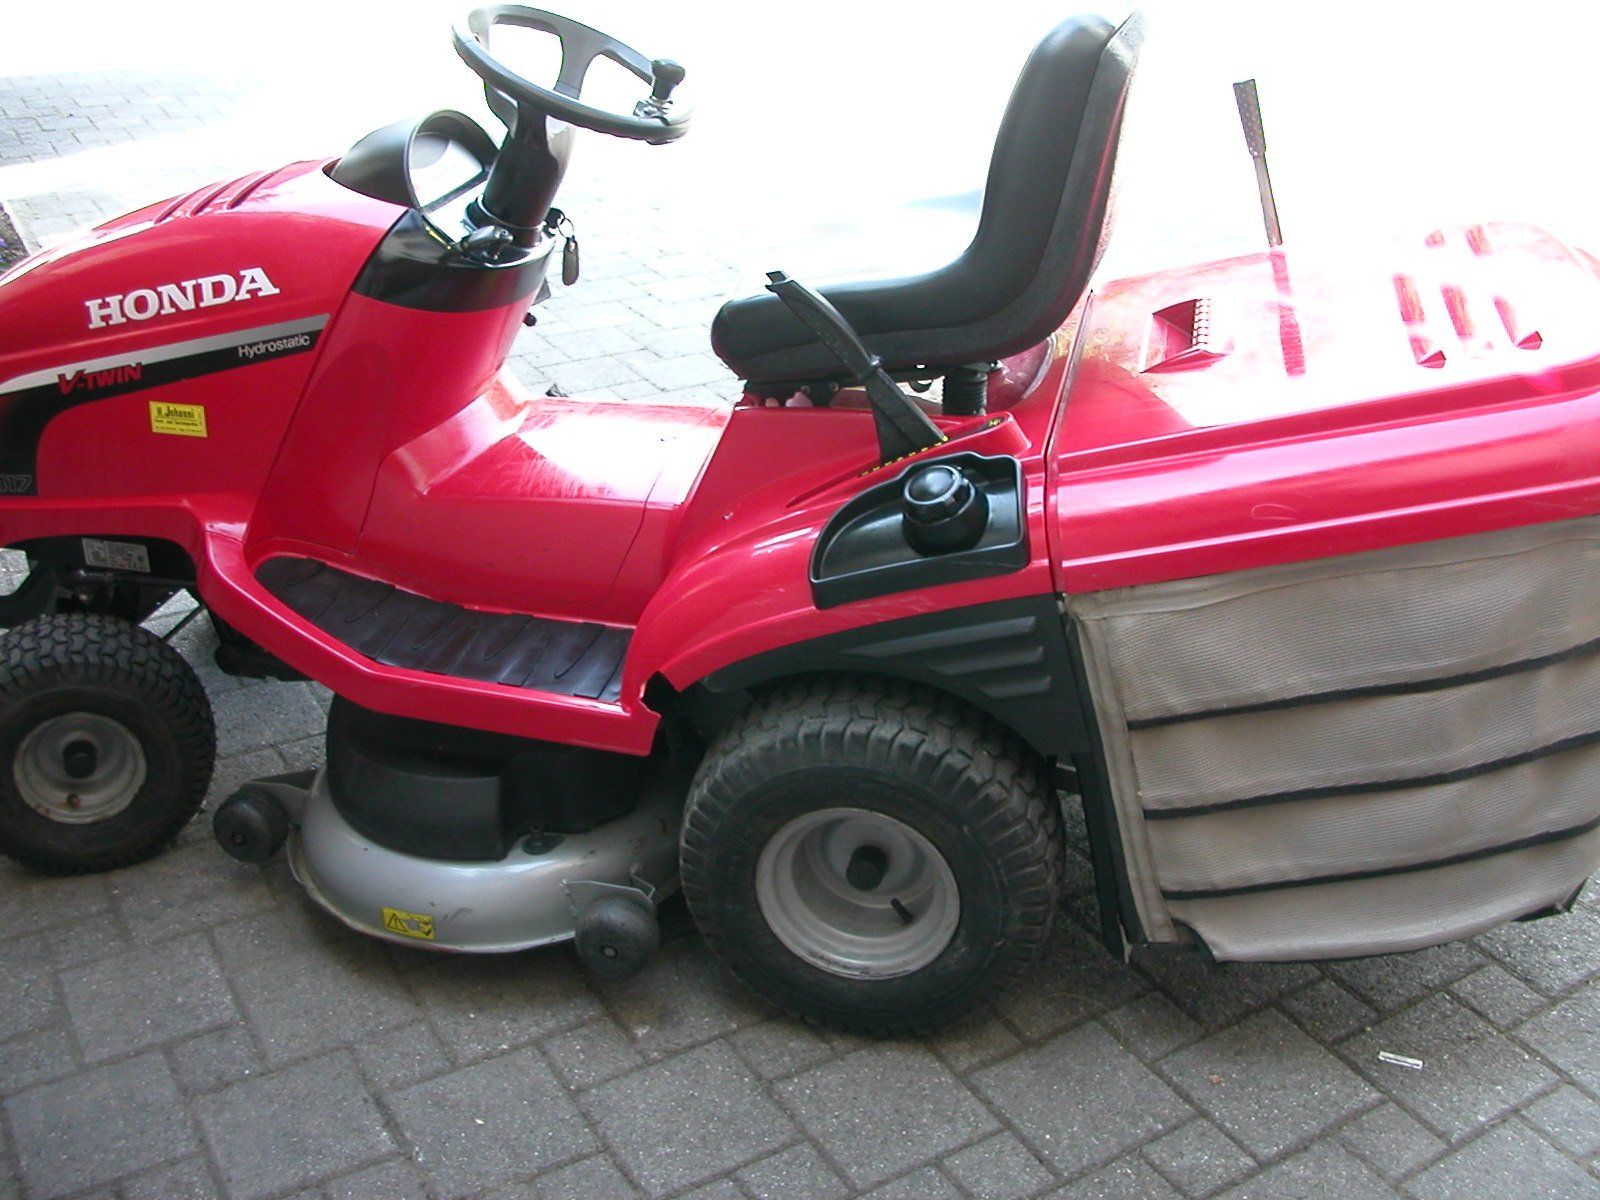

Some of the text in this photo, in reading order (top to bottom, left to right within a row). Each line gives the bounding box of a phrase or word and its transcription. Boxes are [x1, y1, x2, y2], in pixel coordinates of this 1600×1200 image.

[85, 267, 280, 329] HONDA
[238, 334, 311, 358] Hydrostatic
[57, 362, 143, 395] V-TWIN
